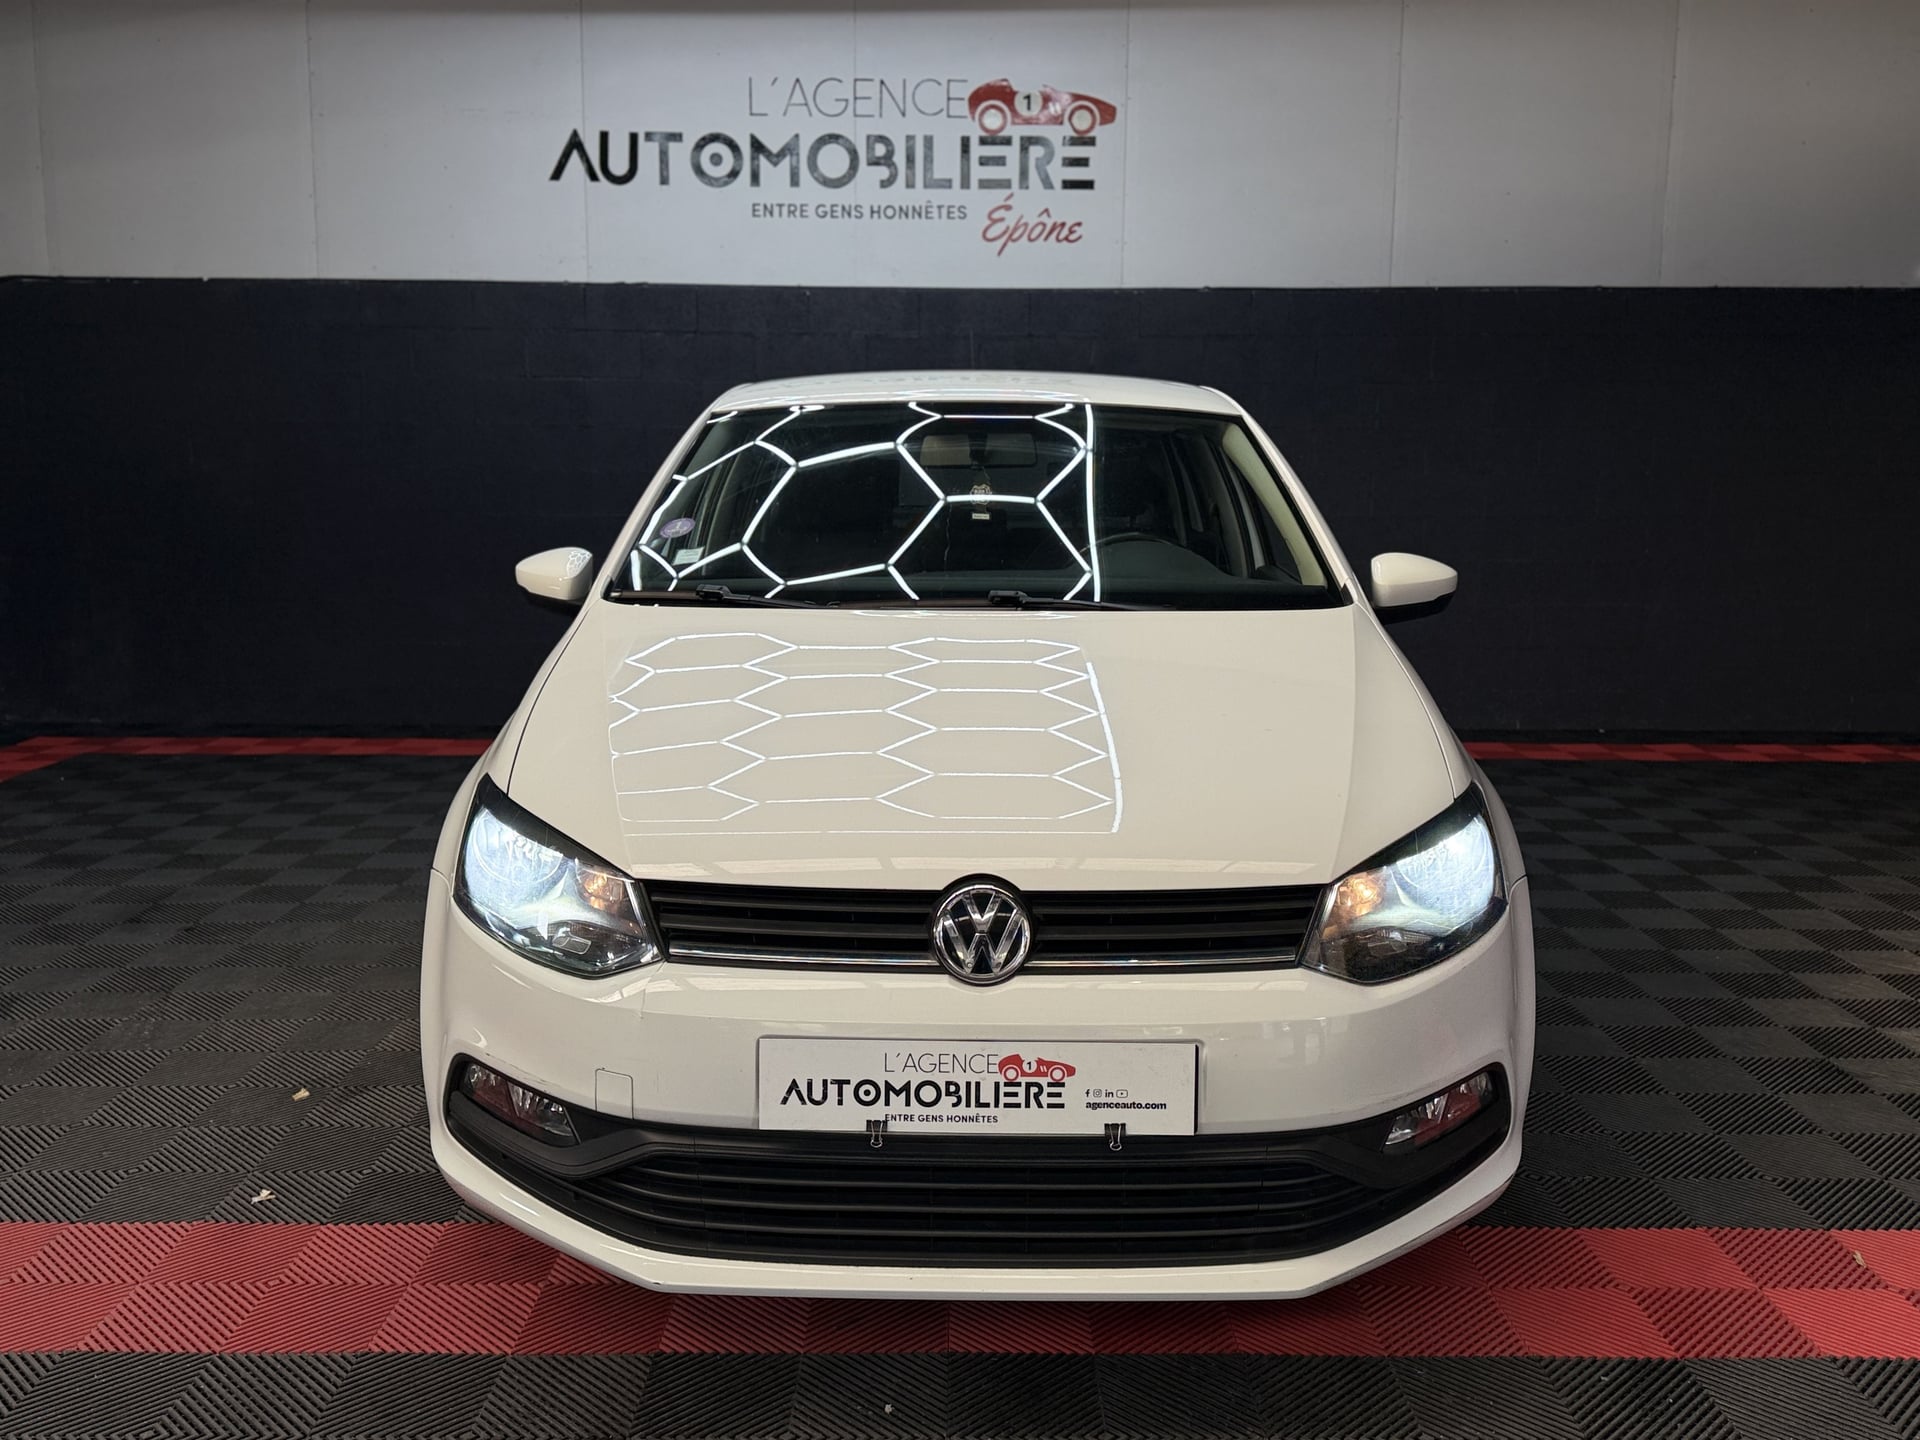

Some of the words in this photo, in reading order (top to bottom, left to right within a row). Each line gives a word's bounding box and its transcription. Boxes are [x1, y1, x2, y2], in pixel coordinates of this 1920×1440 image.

[748, 77, 968, 118] L'AGENCE
[1023, 93, 1032, 111] 1
[751, 203, 809, 218] ENTRE
[815, 204, 864, 219] GENS
[869, 201, 968, 220] HONNÊTES
[981, 192, 1084, 257] Épône
[884, 1052, 999, 1074] L'AGENCE
[1026, 1062, 1032, 1071] 1
[1085, 1101, 1167, 1110] agenceauto.com
[885, 1113, 915, 1123] ENTRE
[918, 1114, 944, 1123] GENS
[946, 1112, 998, 1124] HONNÊTES
